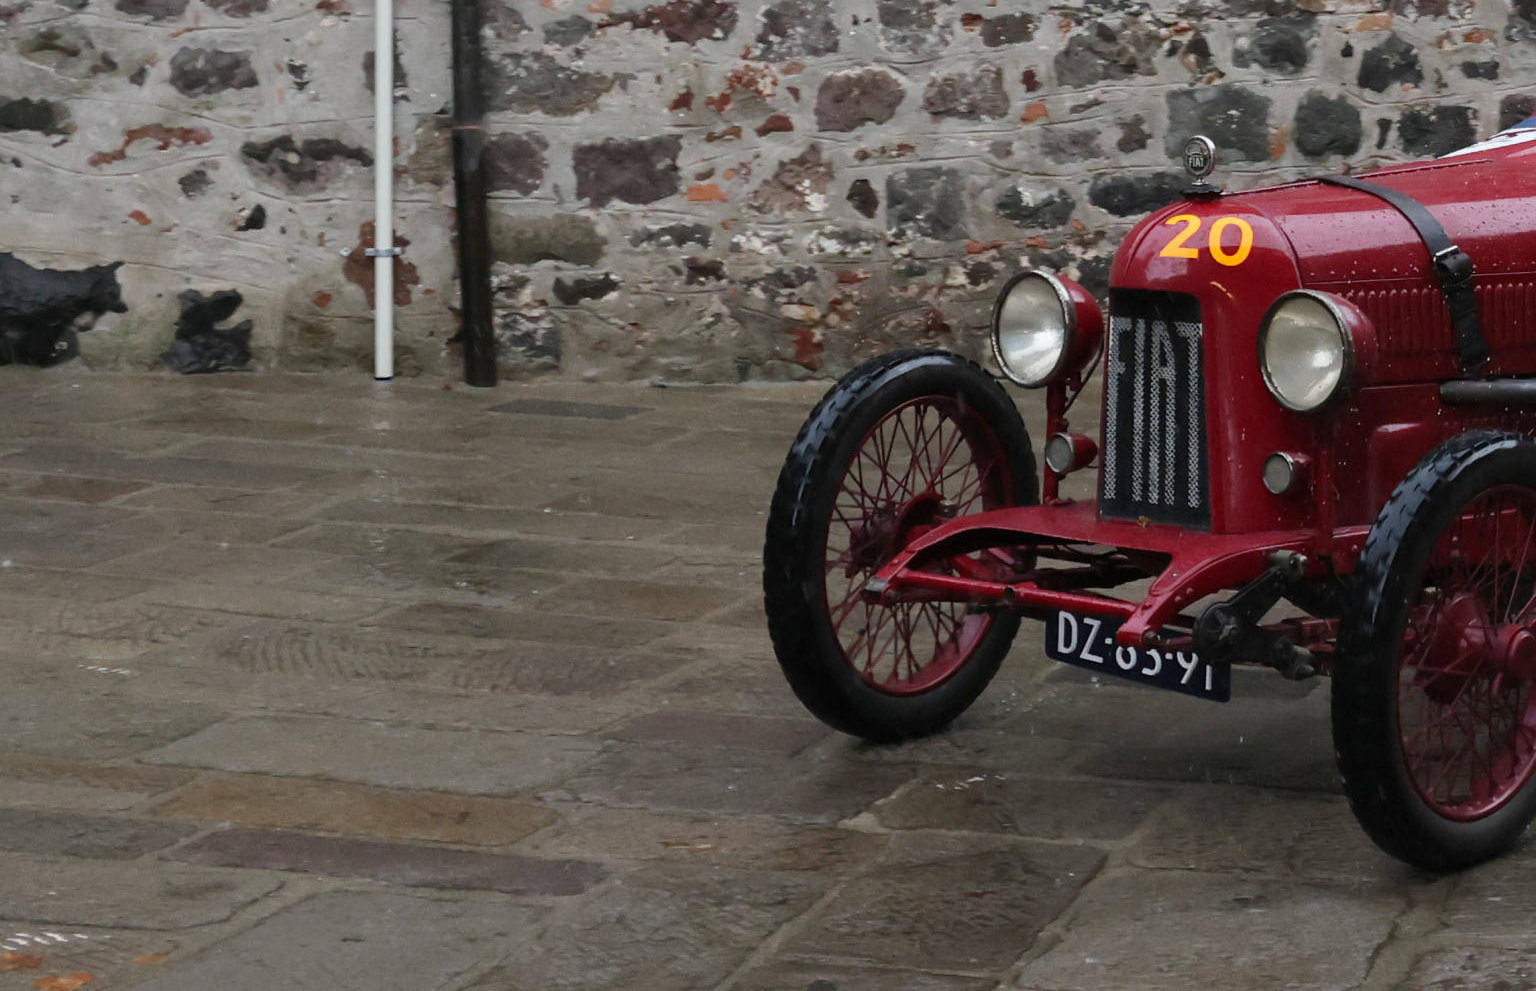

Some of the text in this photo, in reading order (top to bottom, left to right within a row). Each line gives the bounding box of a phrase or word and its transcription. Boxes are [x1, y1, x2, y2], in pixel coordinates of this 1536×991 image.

[1189, 157, 1204, 167] FIAT
[1159, 214, 1254, 267] 20
[1103, 315, 1204, 509] FIAT
